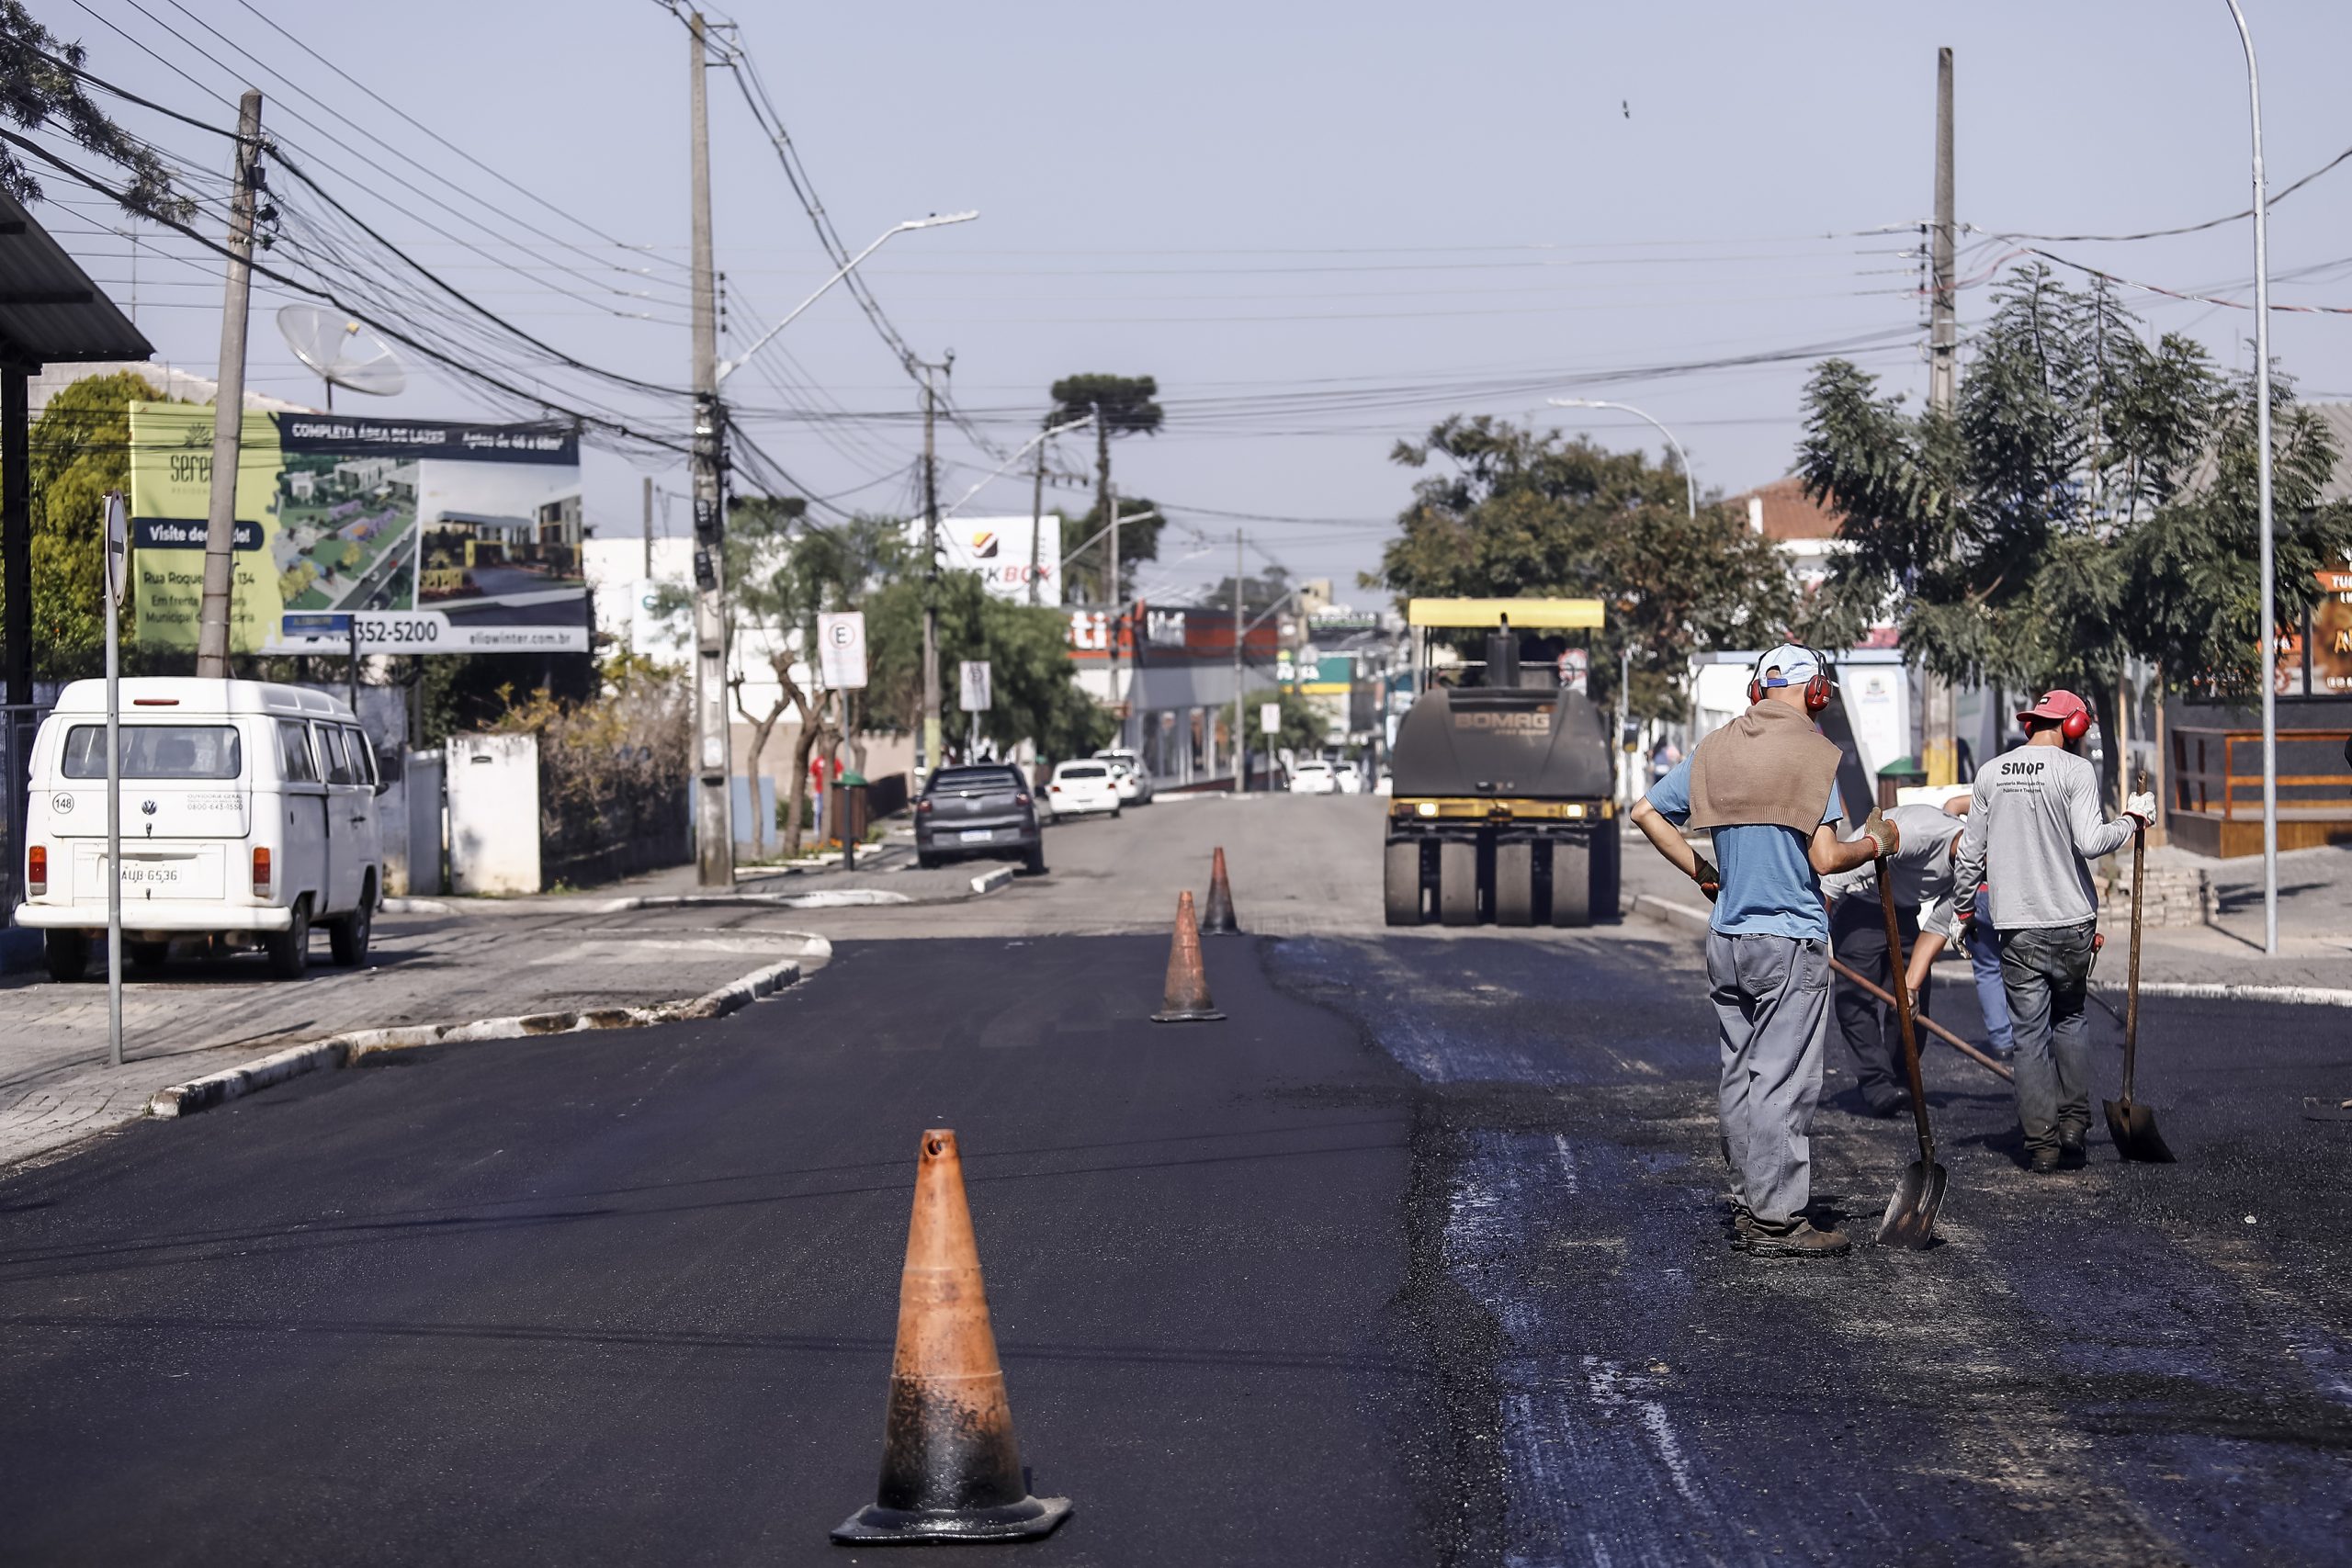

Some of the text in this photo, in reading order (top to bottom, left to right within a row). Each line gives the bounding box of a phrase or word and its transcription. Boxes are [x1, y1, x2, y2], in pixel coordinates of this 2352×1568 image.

[291, 423, 356, 439] COMPLETA
[391, 428, 409, 442] DE
[410, 429, 447, 444] LAZER
[149, 525, 187, 541] Visite
[143, 571, 165, 584] Rua
[168, 571, 204, 587] Roque
[836, 626, 846, 644] E
[1454, 713, 1551, 728] BOMAG
[2001, 762, 2045, 775] SMOP
[55, 798, 72, 808] 148
[148, 870, 177, 881] 6536
